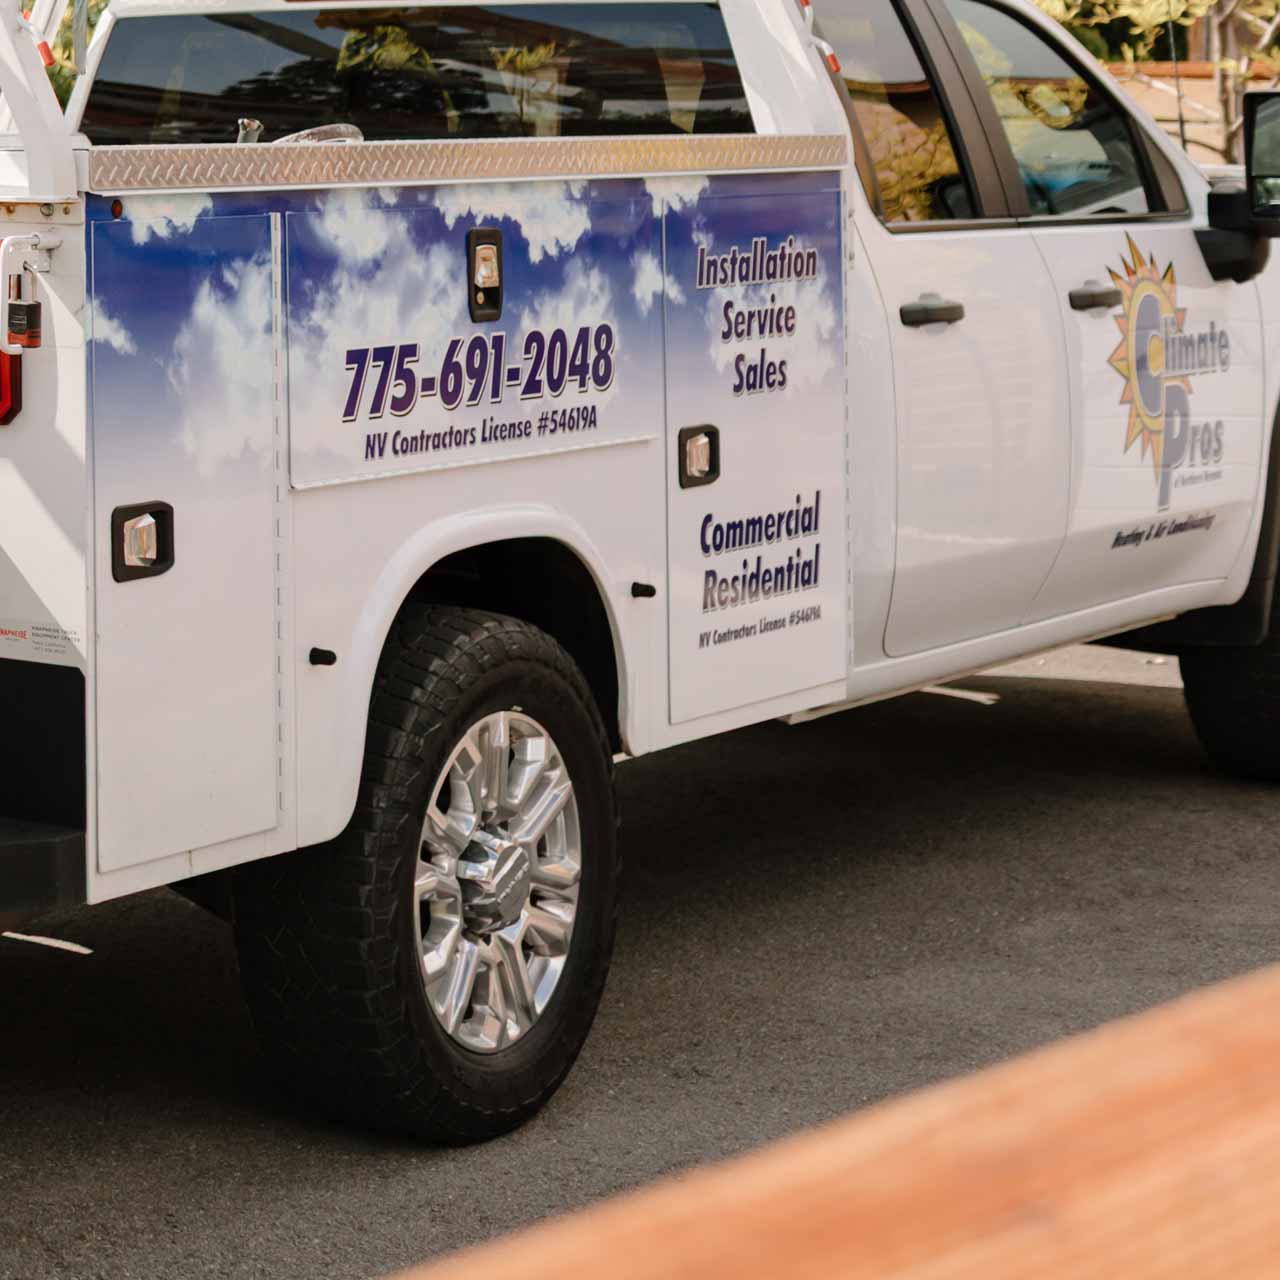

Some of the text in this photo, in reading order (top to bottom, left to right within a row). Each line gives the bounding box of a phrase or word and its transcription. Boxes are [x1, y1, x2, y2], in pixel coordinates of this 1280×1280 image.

[696, 235, 818, 289] Installation
[721, 293, 797, 342] Service
[342, 323, 616, 423] 775-691-2048
[733, 348, 789, 395] Sales
[1134, 293, 1232, 418] Climate
[364, 405, 598, 460] NV Contractors License #54619A
[1158, 382, 1225, 512] Pros
[700, 490, 821, 556] Commercial
[702, 543, 821, 613] Residential
[698, 631, 712, 649] NV
[713, 622, 757, 646] Contractors
[759, 615, 787, 634] License
